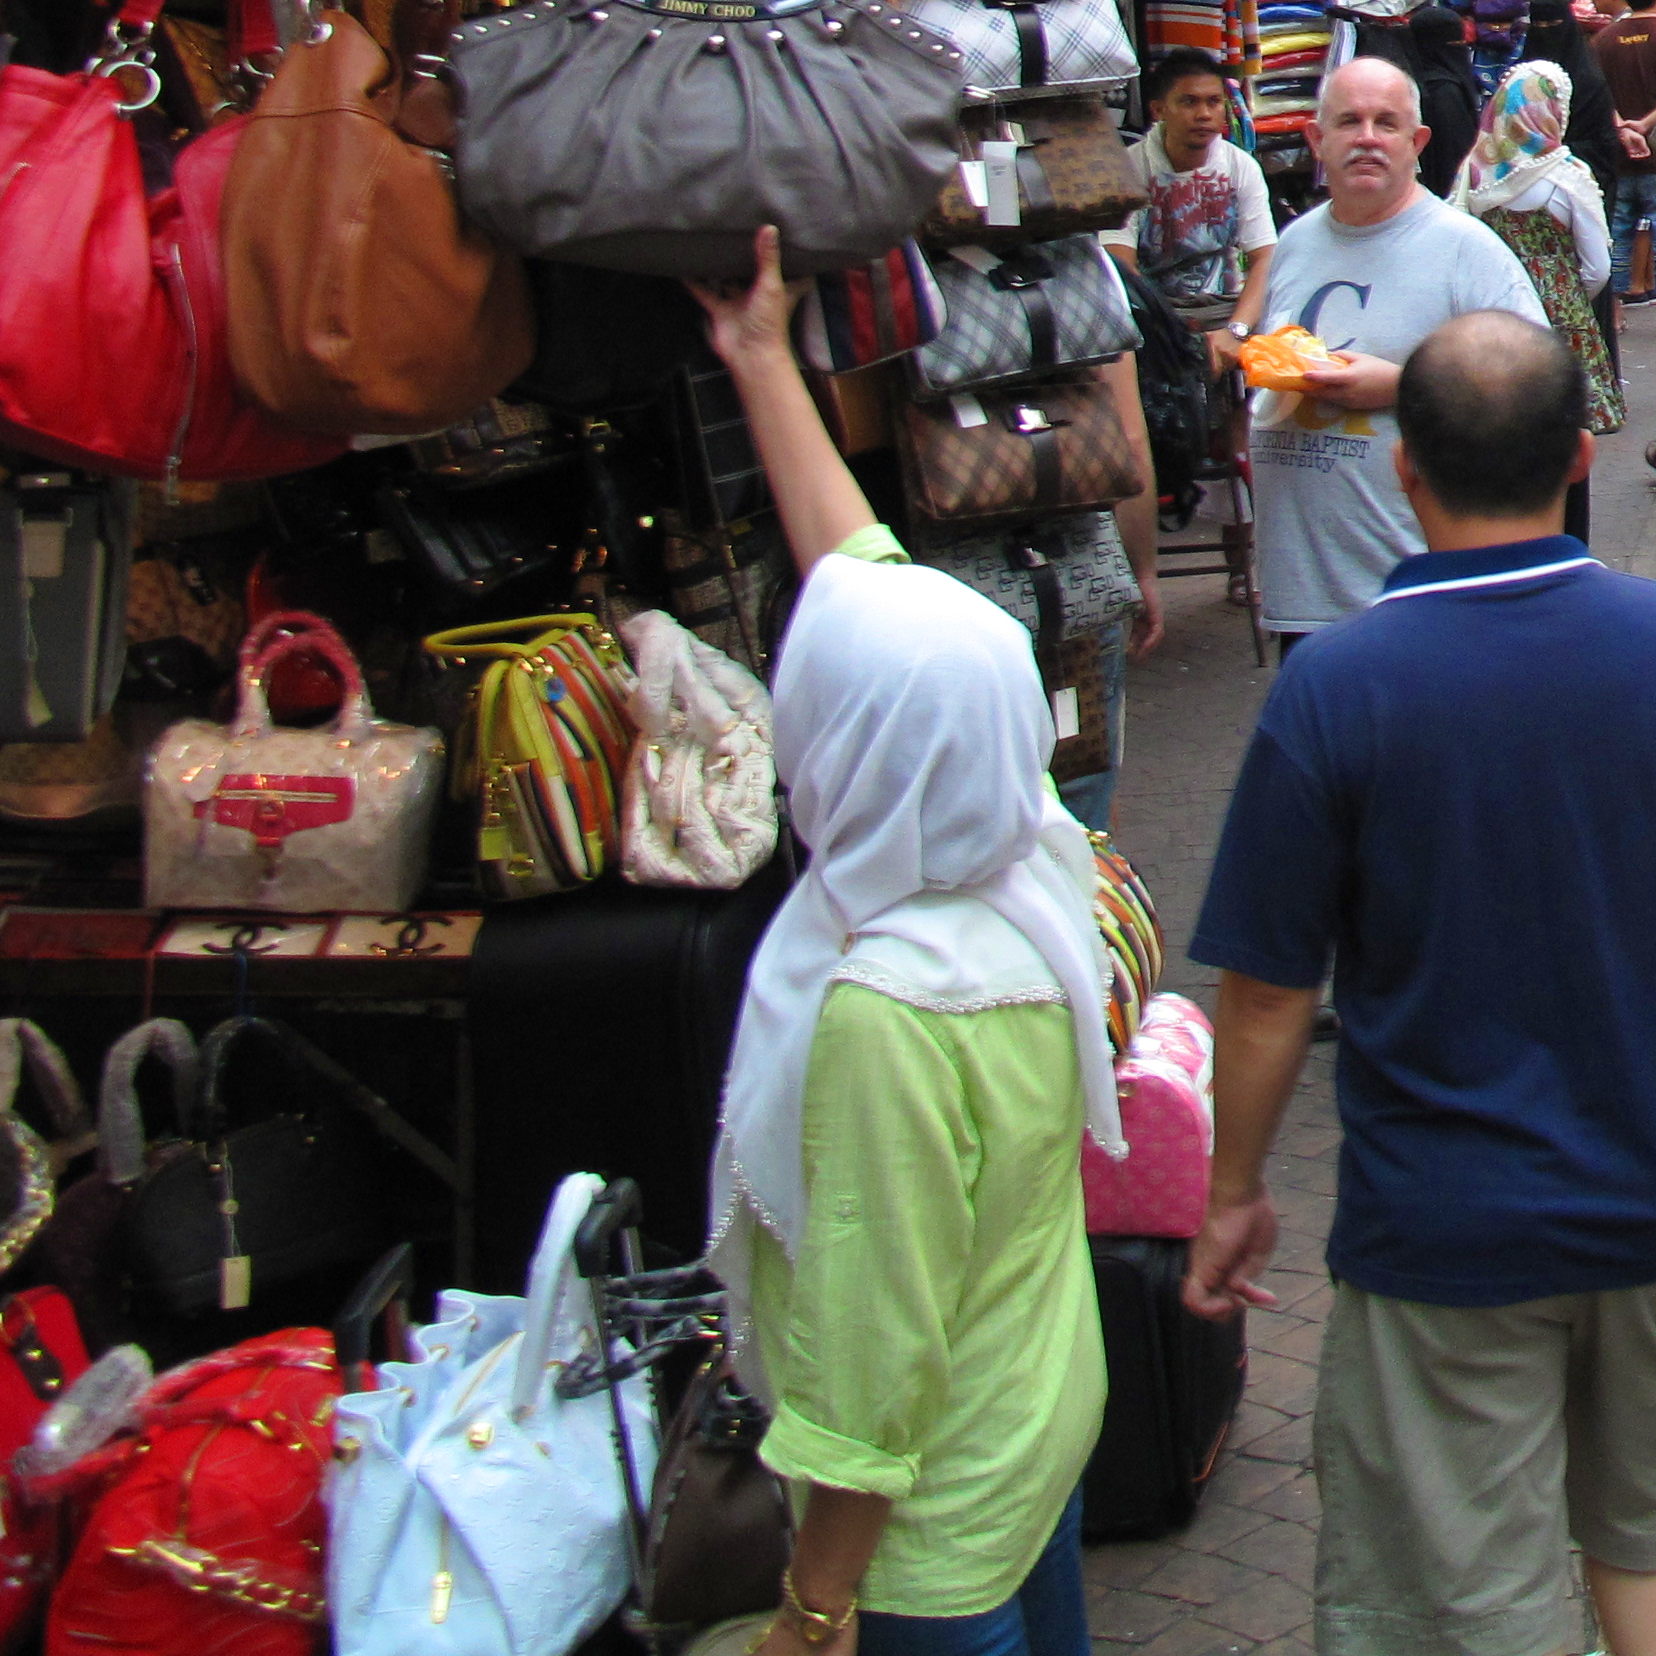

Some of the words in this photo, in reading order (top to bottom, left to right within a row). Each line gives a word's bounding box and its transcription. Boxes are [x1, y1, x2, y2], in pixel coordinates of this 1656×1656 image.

[713, 5, 756, 18] CHOO
[1299, 280, 1373, 352] C
[1299, 432, 1371, 459] BAPTIST
